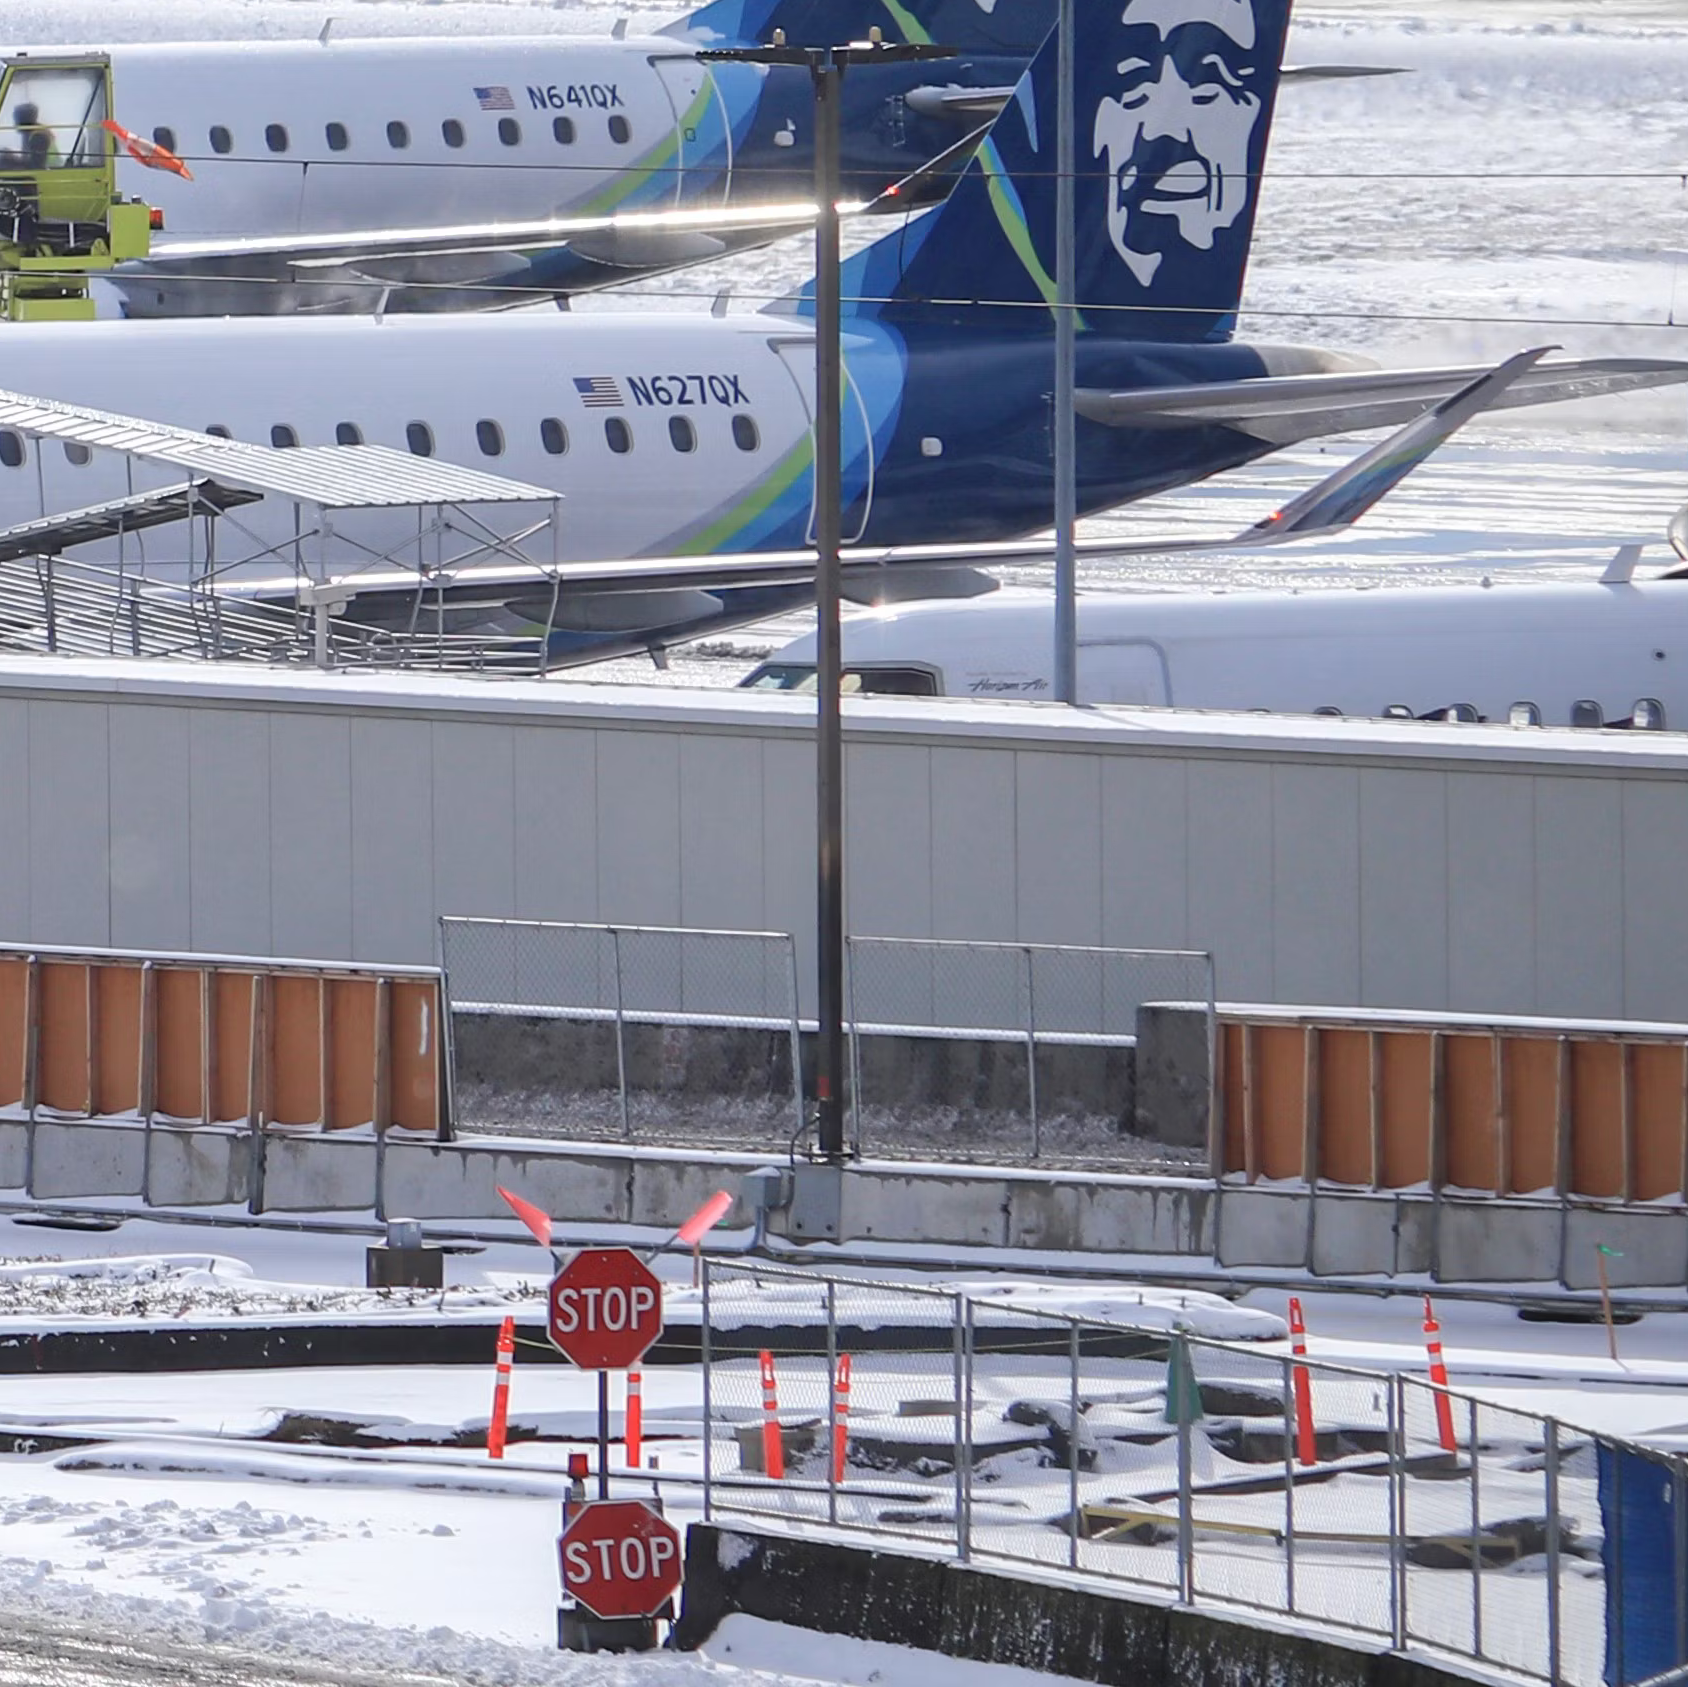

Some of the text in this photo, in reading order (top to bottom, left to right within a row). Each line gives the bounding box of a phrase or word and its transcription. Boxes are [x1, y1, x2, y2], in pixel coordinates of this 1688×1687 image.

[526, 84, 625, 110] N641QX
[625, 374, 751, 406] N627QX
[554, 1285, 656, 1333] STOP
[565, 1535, 676, 1584] STOP
